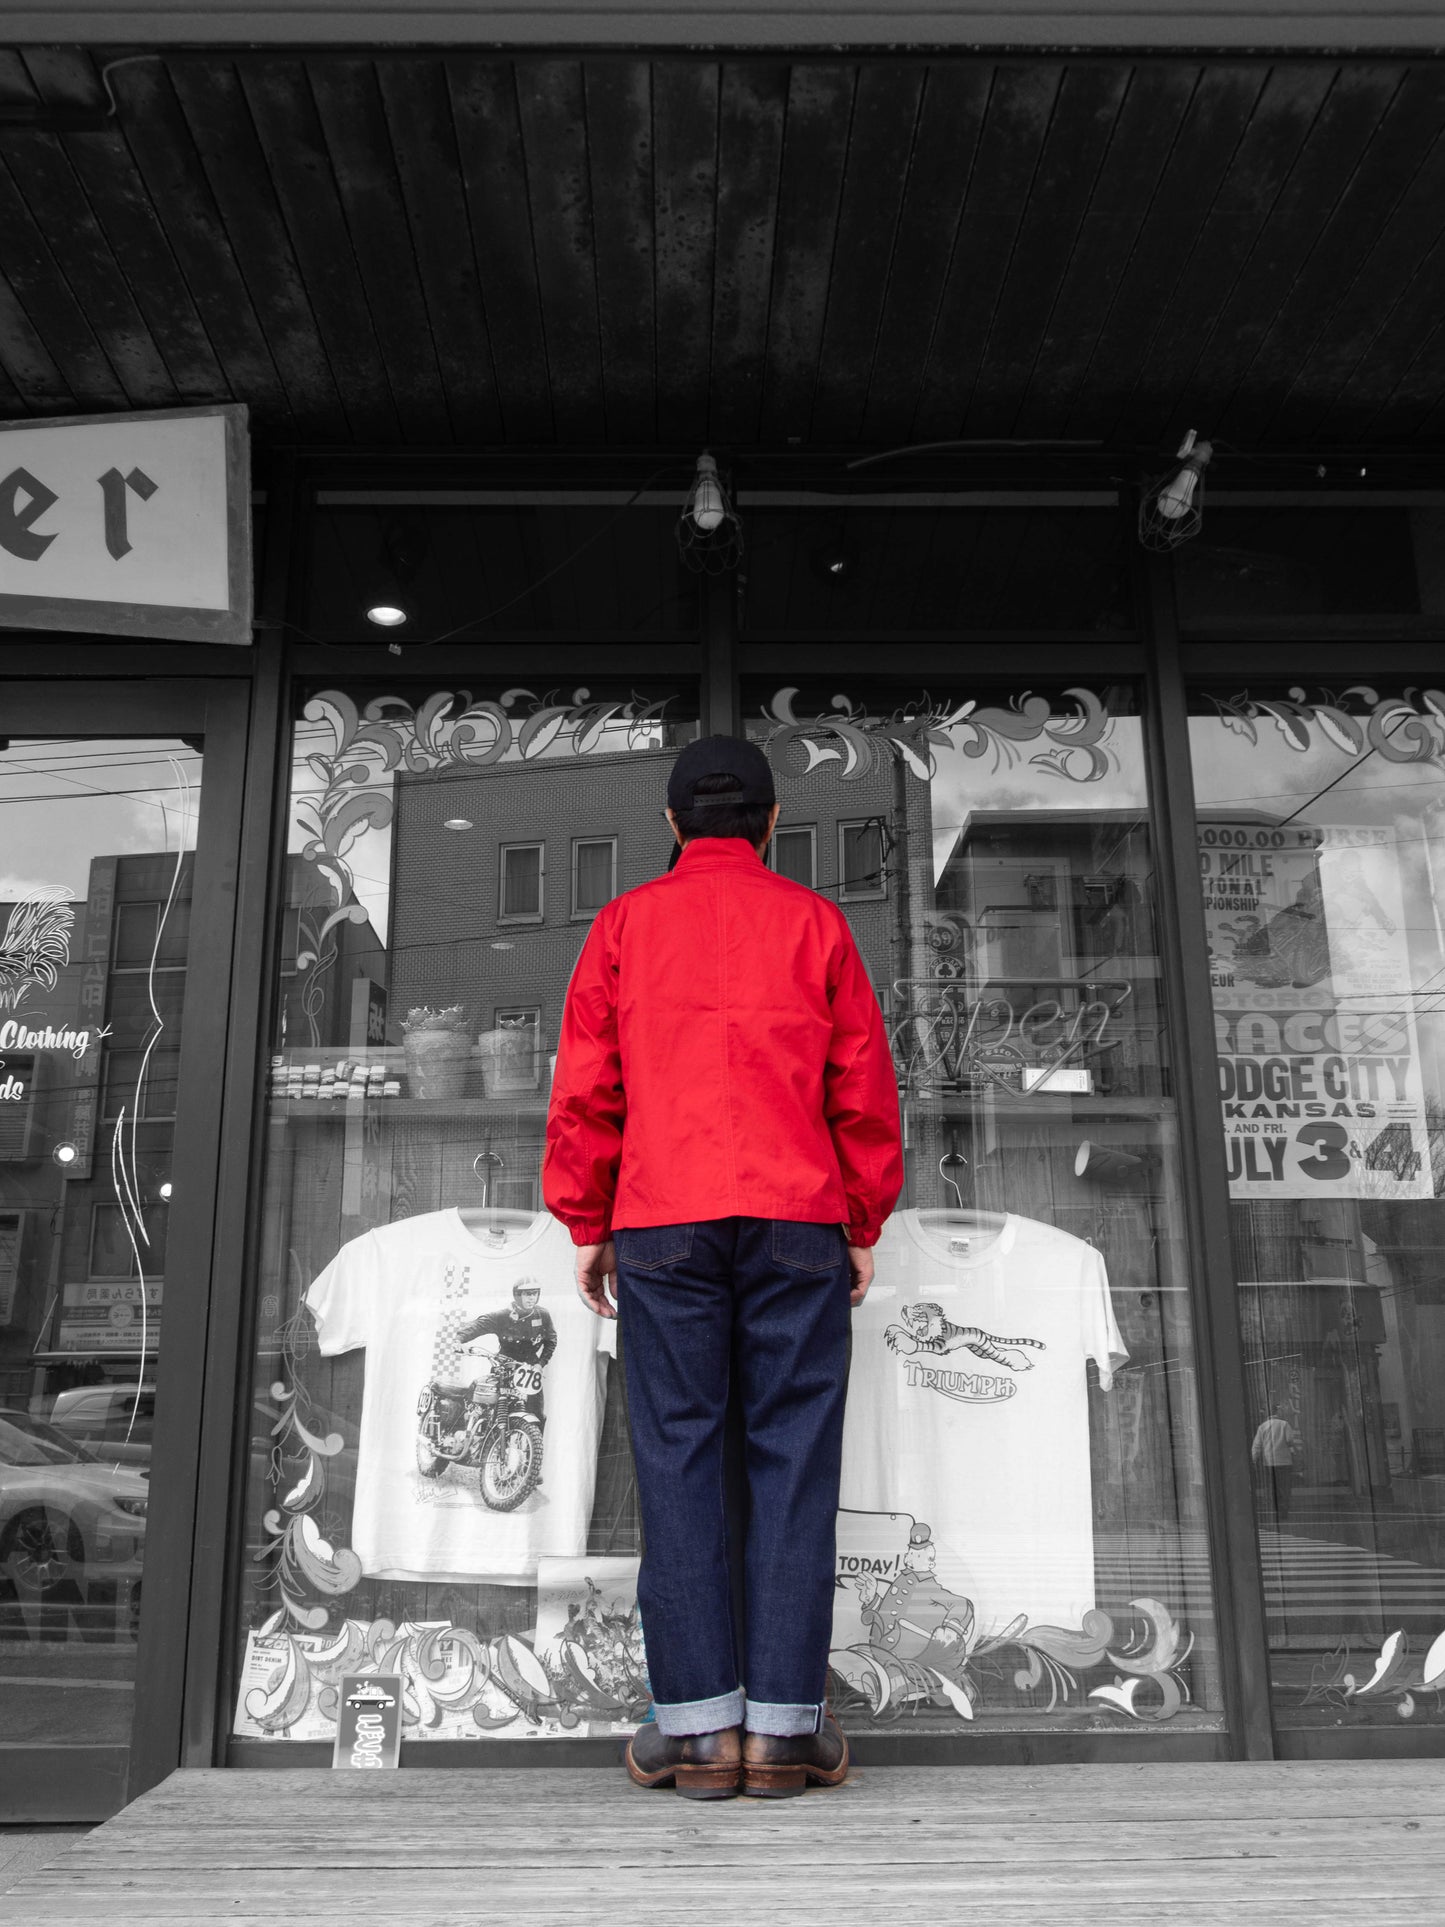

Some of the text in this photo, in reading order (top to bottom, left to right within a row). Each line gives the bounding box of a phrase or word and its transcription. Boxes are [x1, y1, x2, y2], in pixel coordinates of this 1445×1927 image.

[0, 466, 160, 562] er
[1219, 853, 1275, 877] MILE
[1203, 896, 1260, 913] PIONSHIP
[0, 1019, 91, 1059] Clothing
[1215, 1011, 1409, 1054] RACES
[1322, 1056, 1411, 1102] CITY
[1225, 1102, 1377, 1119] KANSAS
[1234, 1123, 1260, 1134] AND
[1264, 1123, 1287, 1134] FRI.
[1295, 1120, 1351, 1181] 3
[1349, 1140, 1363, 1159] &
[1364, 1122, 1422, 1182] 4
[515, 1367, 542, 1391] 278
[903, 1359, 1017, 1401] TRIUMPH
[838, 1554, 901, 1578] TODAY!
